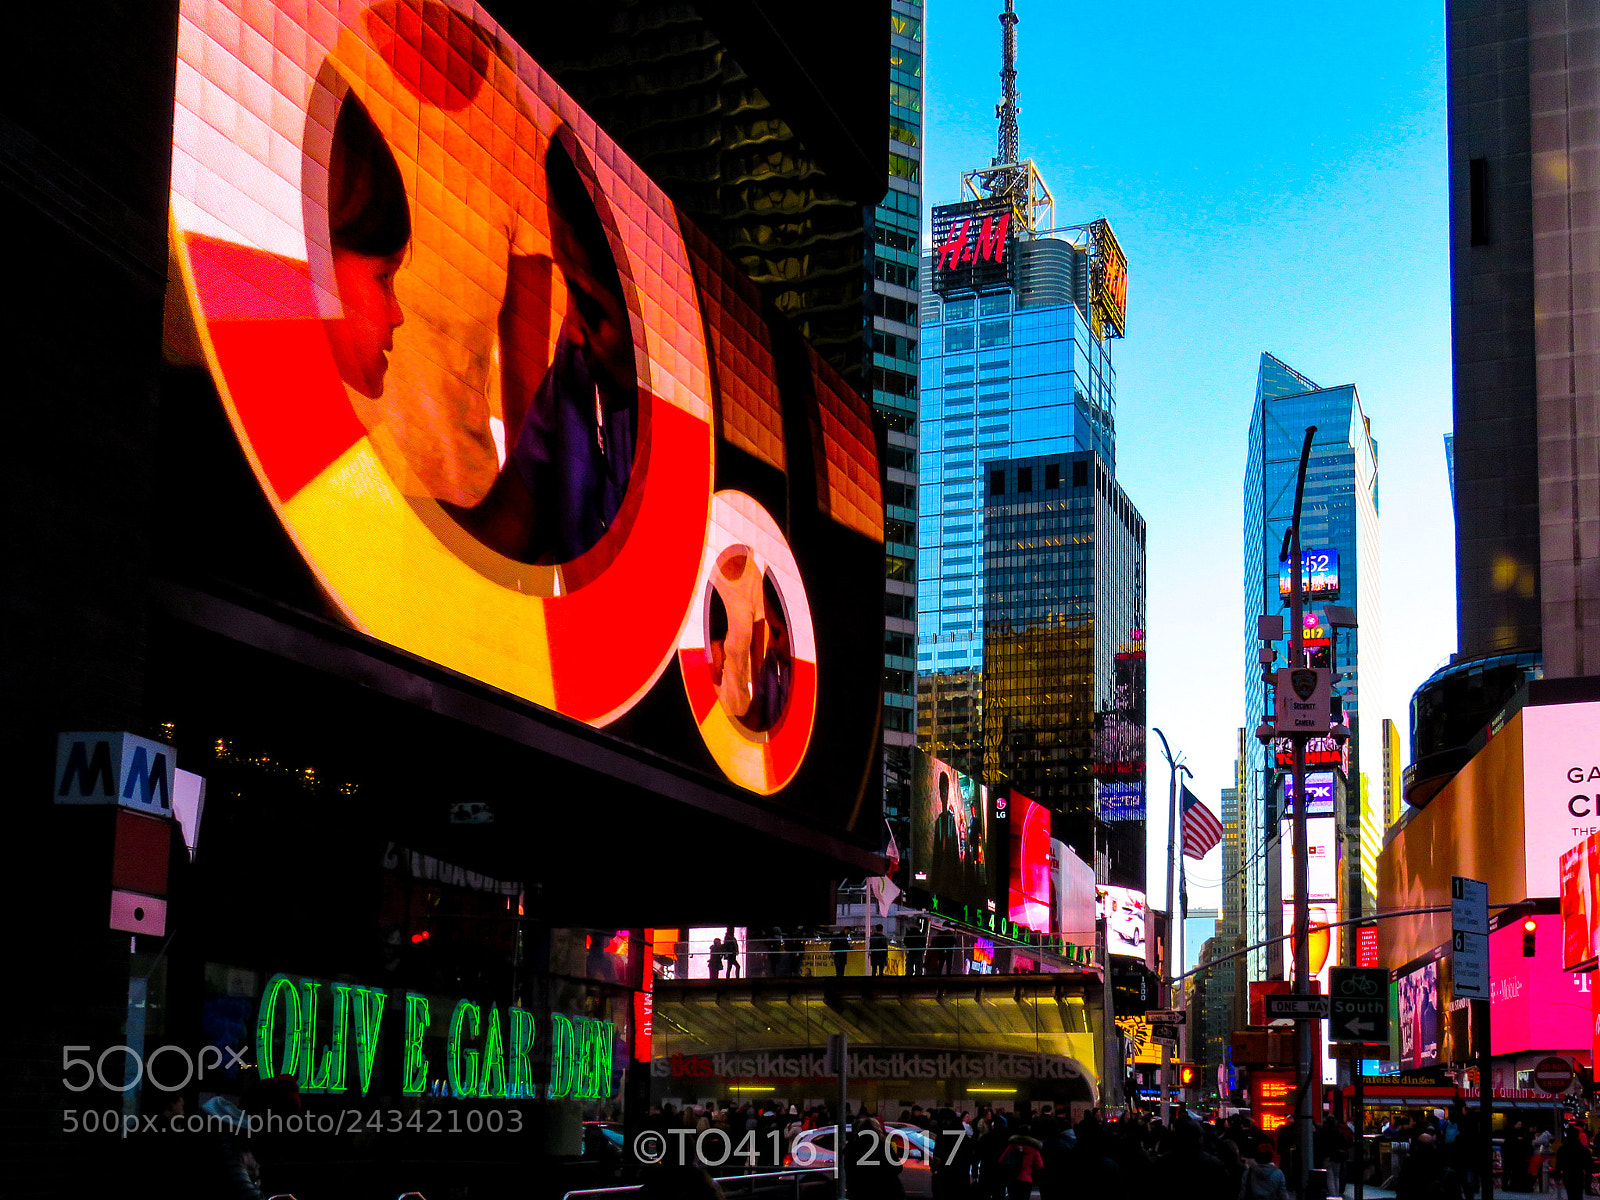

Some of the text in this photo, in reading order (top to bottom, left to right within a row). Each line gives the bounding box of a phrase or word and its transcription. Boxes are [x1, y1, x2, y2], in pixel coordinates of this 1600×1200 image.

[937, 213, 1010, 270] H&M
[1275, 750, 1342, 765] TOHIBA
[122, 745, 170, 810] M
[996, 811, 1006, 819] LG
[1455, 879, 1461, 898] 1
[963, 904, 1007, 936] 1540
[1013, 922, 1094, 965] BRADWAY
[1455, 931, 1462, 951] 6
[1276, 1001, 1329, 1012] ONE WAY
[1335, 1001, 1384, 1013] South
[256, 973, 430, 1096] OLIVE
[447, 999, 615, 1100] GARDEN
[1362, 1076, 1391, 1084] afels
[1401, 1075, 1436, 1085] dinges
